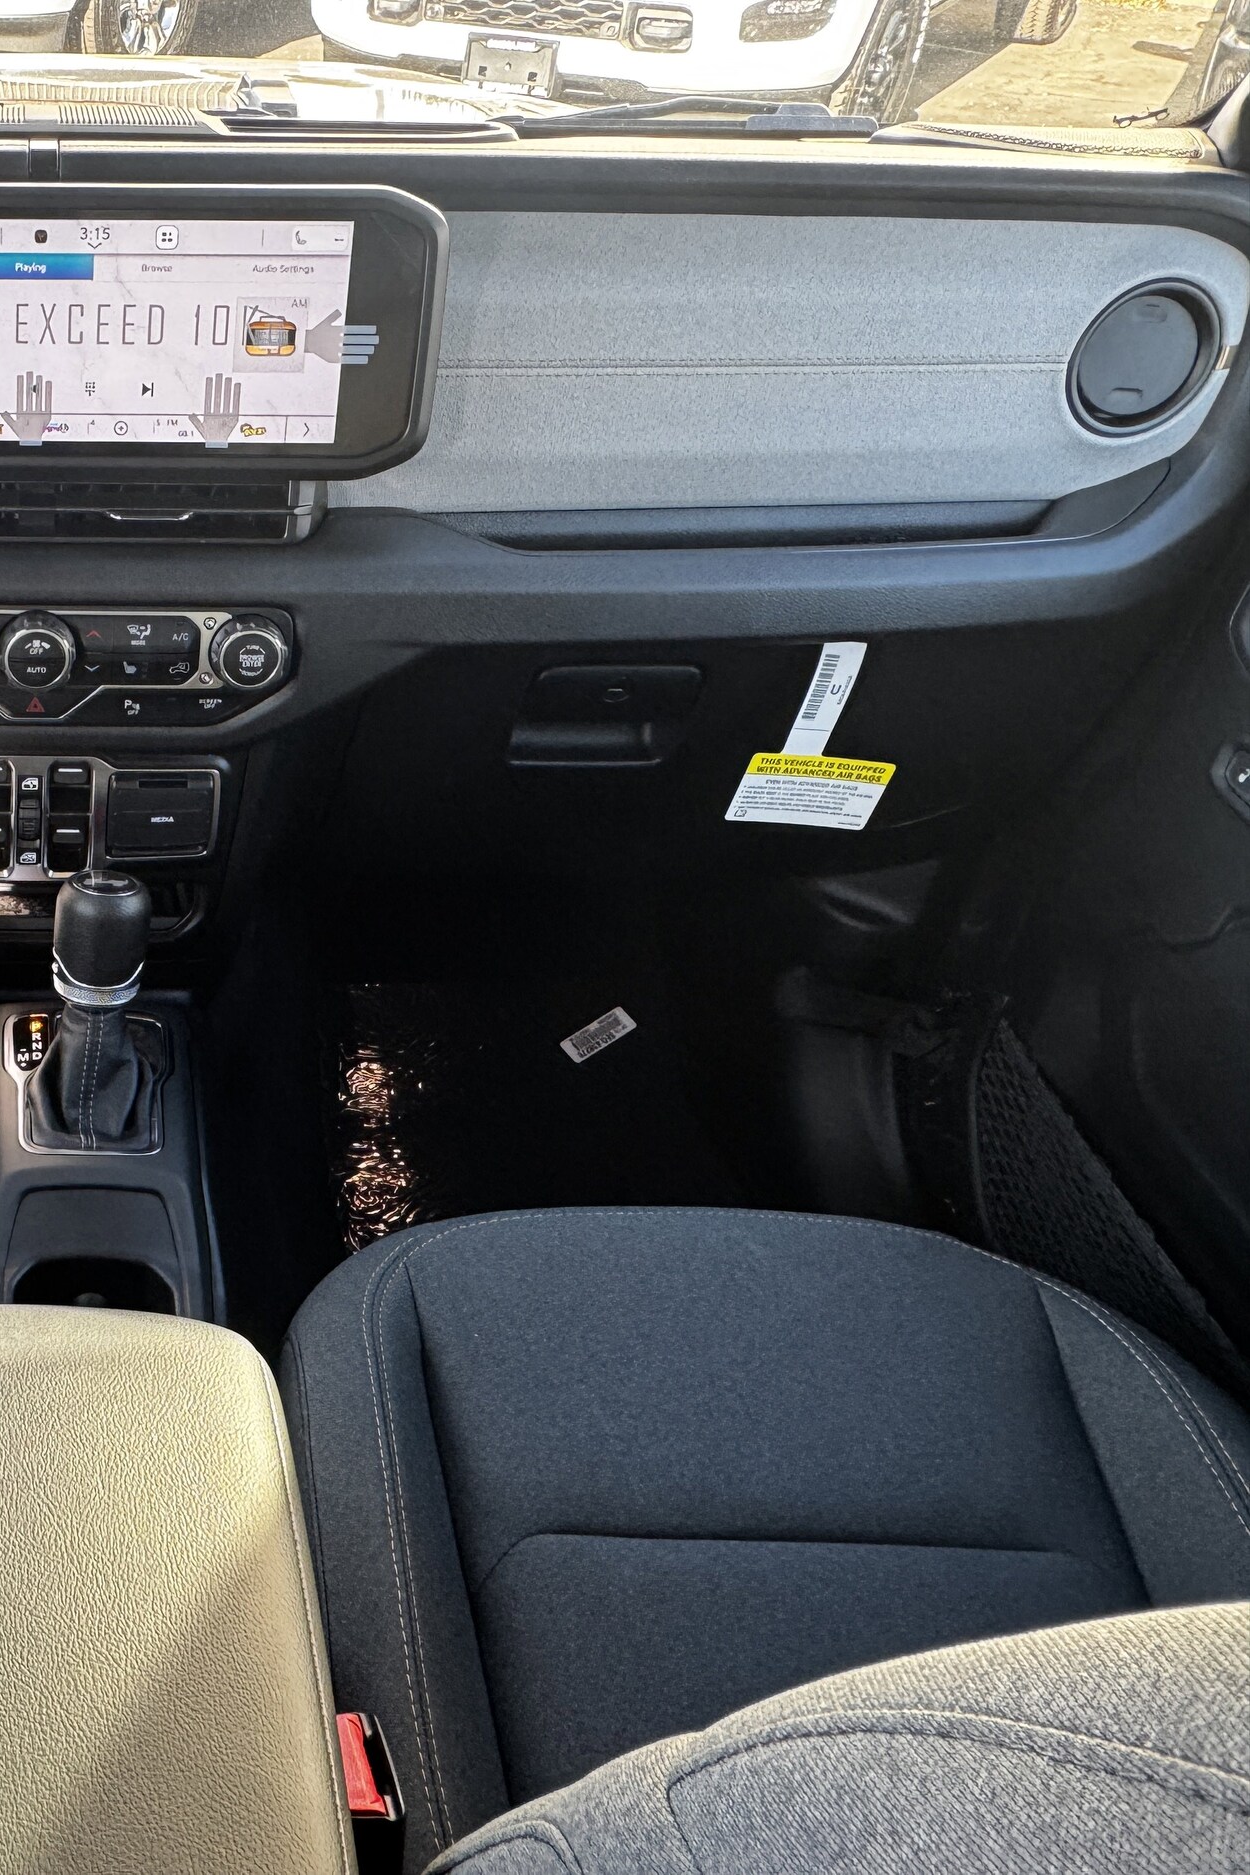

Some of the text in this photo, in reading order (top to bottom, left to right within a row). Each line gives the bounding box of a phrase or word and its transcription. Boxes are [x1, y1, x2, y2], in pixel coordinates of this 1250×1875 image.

[79, 226, 111, 240] 3:15
[14, 262, 47, 274] Playing
[141, 264, 173, 273] Browse
[291, 299, 308, 309] AM
[16, 303, 165, 345] EXCEED
[172, 633, 189, 641] A/C
[760, 757, 782, 766] THIS
[784, 759, 823, 769] VEHICLE
[837, 763, 887, 775] EQUIPPED
[756, 766, 882, 783] WITH ADVANCED AIR BAGS
[30, 1020, 43, 1032] P
[31, 1032, 42, 1041] R
[32, 1041, 43, 1050] N
[17, 1052, 30, 1062] M
[32, 1051, 43, 1060] D
